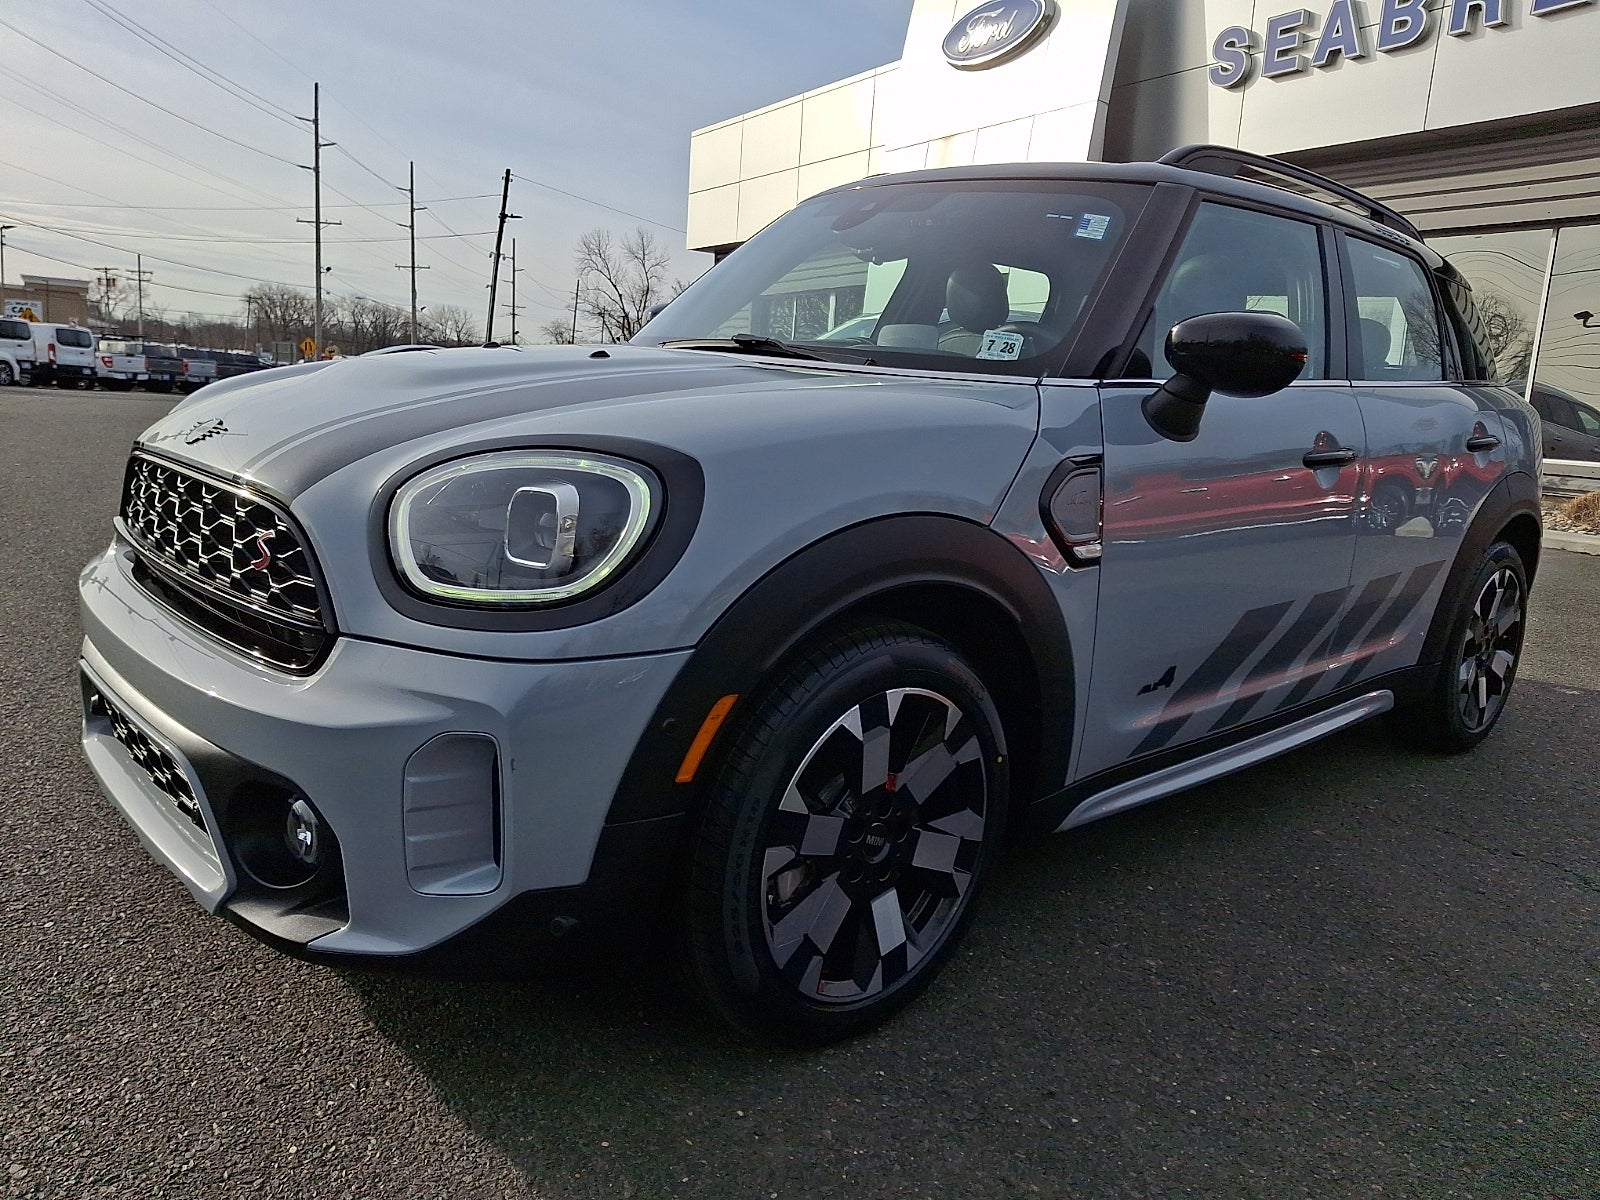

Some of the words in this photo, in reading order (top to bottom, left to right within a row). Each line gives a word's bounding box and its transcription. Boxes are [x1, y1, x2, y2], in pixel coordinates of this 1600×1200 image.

[958, 6, 1019, 53] Ford
[1207, 0, 1595, 89] SEAB
[987, 339, 996, 351] 7
[1000, 341, 1016, 354] 28
